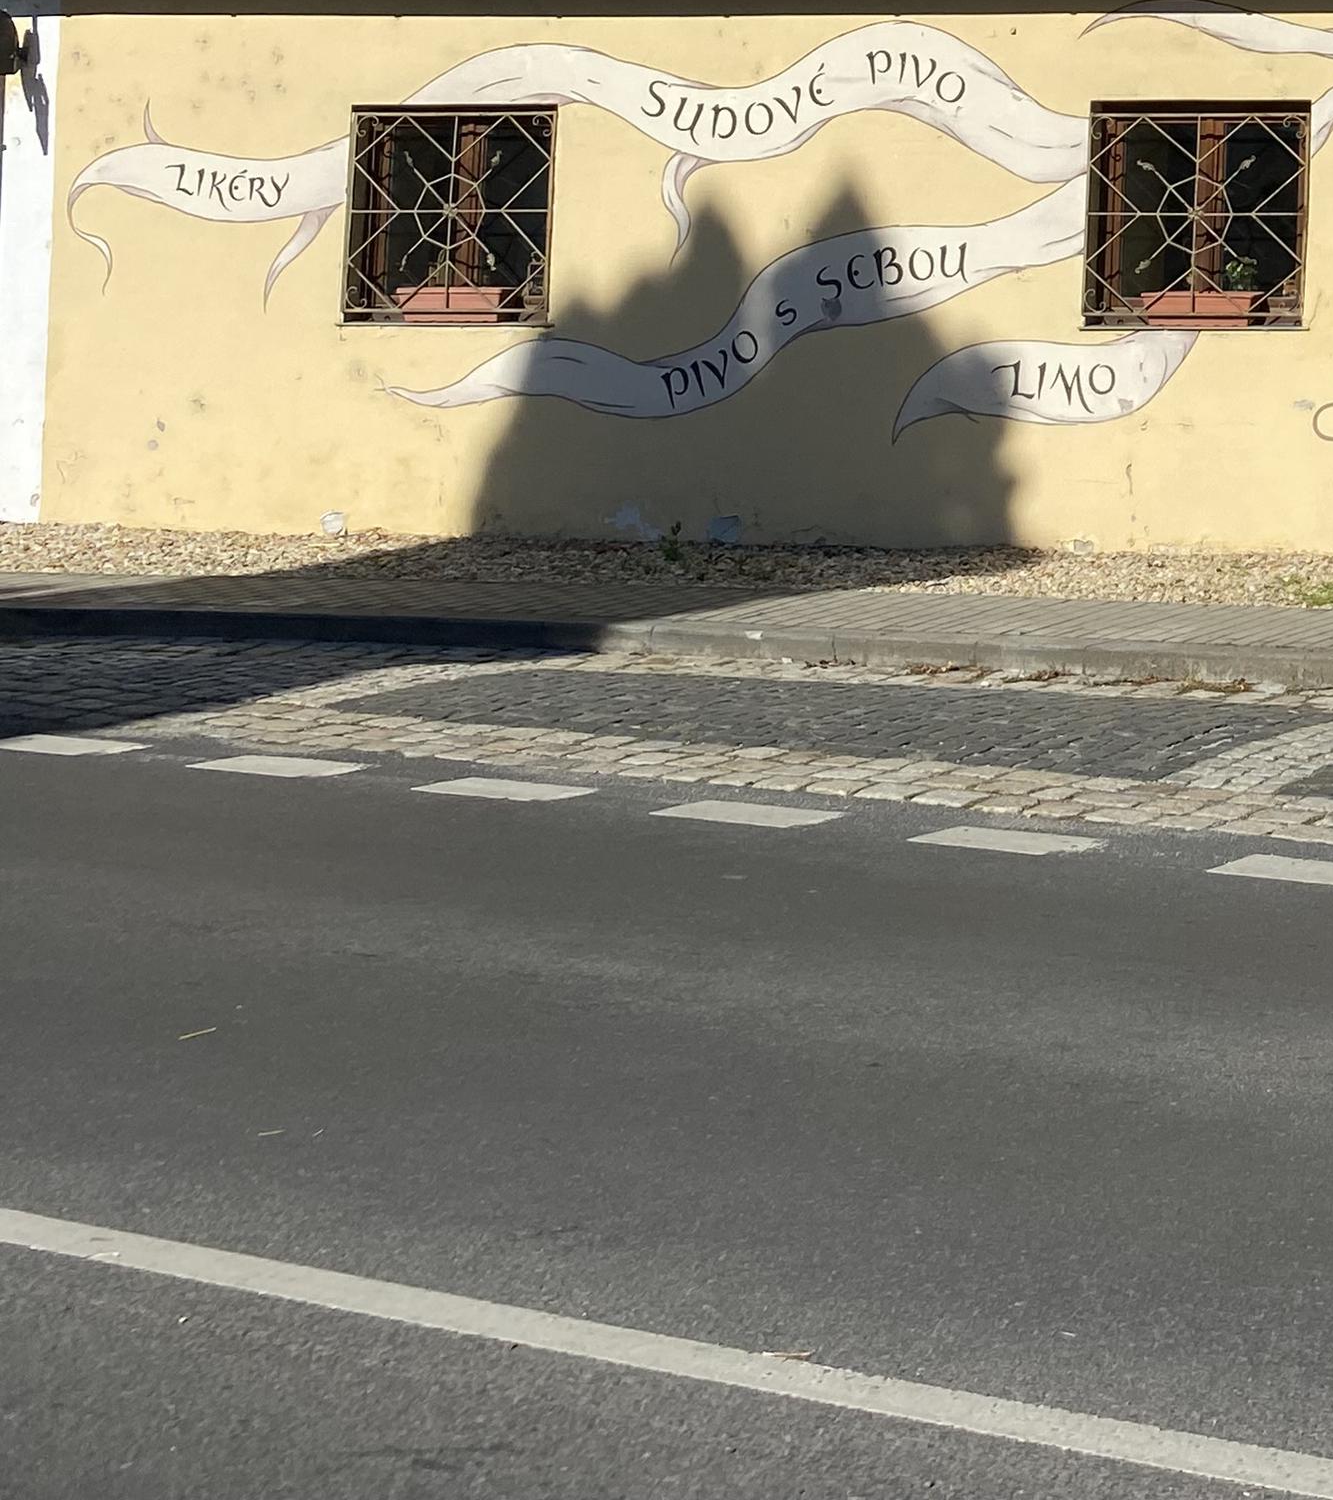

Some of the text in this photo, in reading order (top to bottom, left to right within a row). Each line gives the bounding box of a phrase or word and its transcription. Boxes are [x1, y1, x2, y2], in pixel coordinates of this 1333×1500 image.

[640, 48, 967, 146] SUDOVÉ PIVO
[165, 162, 290, 212] LIKÉRY
[661, 329, 760, 409] PIVO
[815, 241, 970, 305] SEBOU
[991, 358, 1116, 414] LIMO
